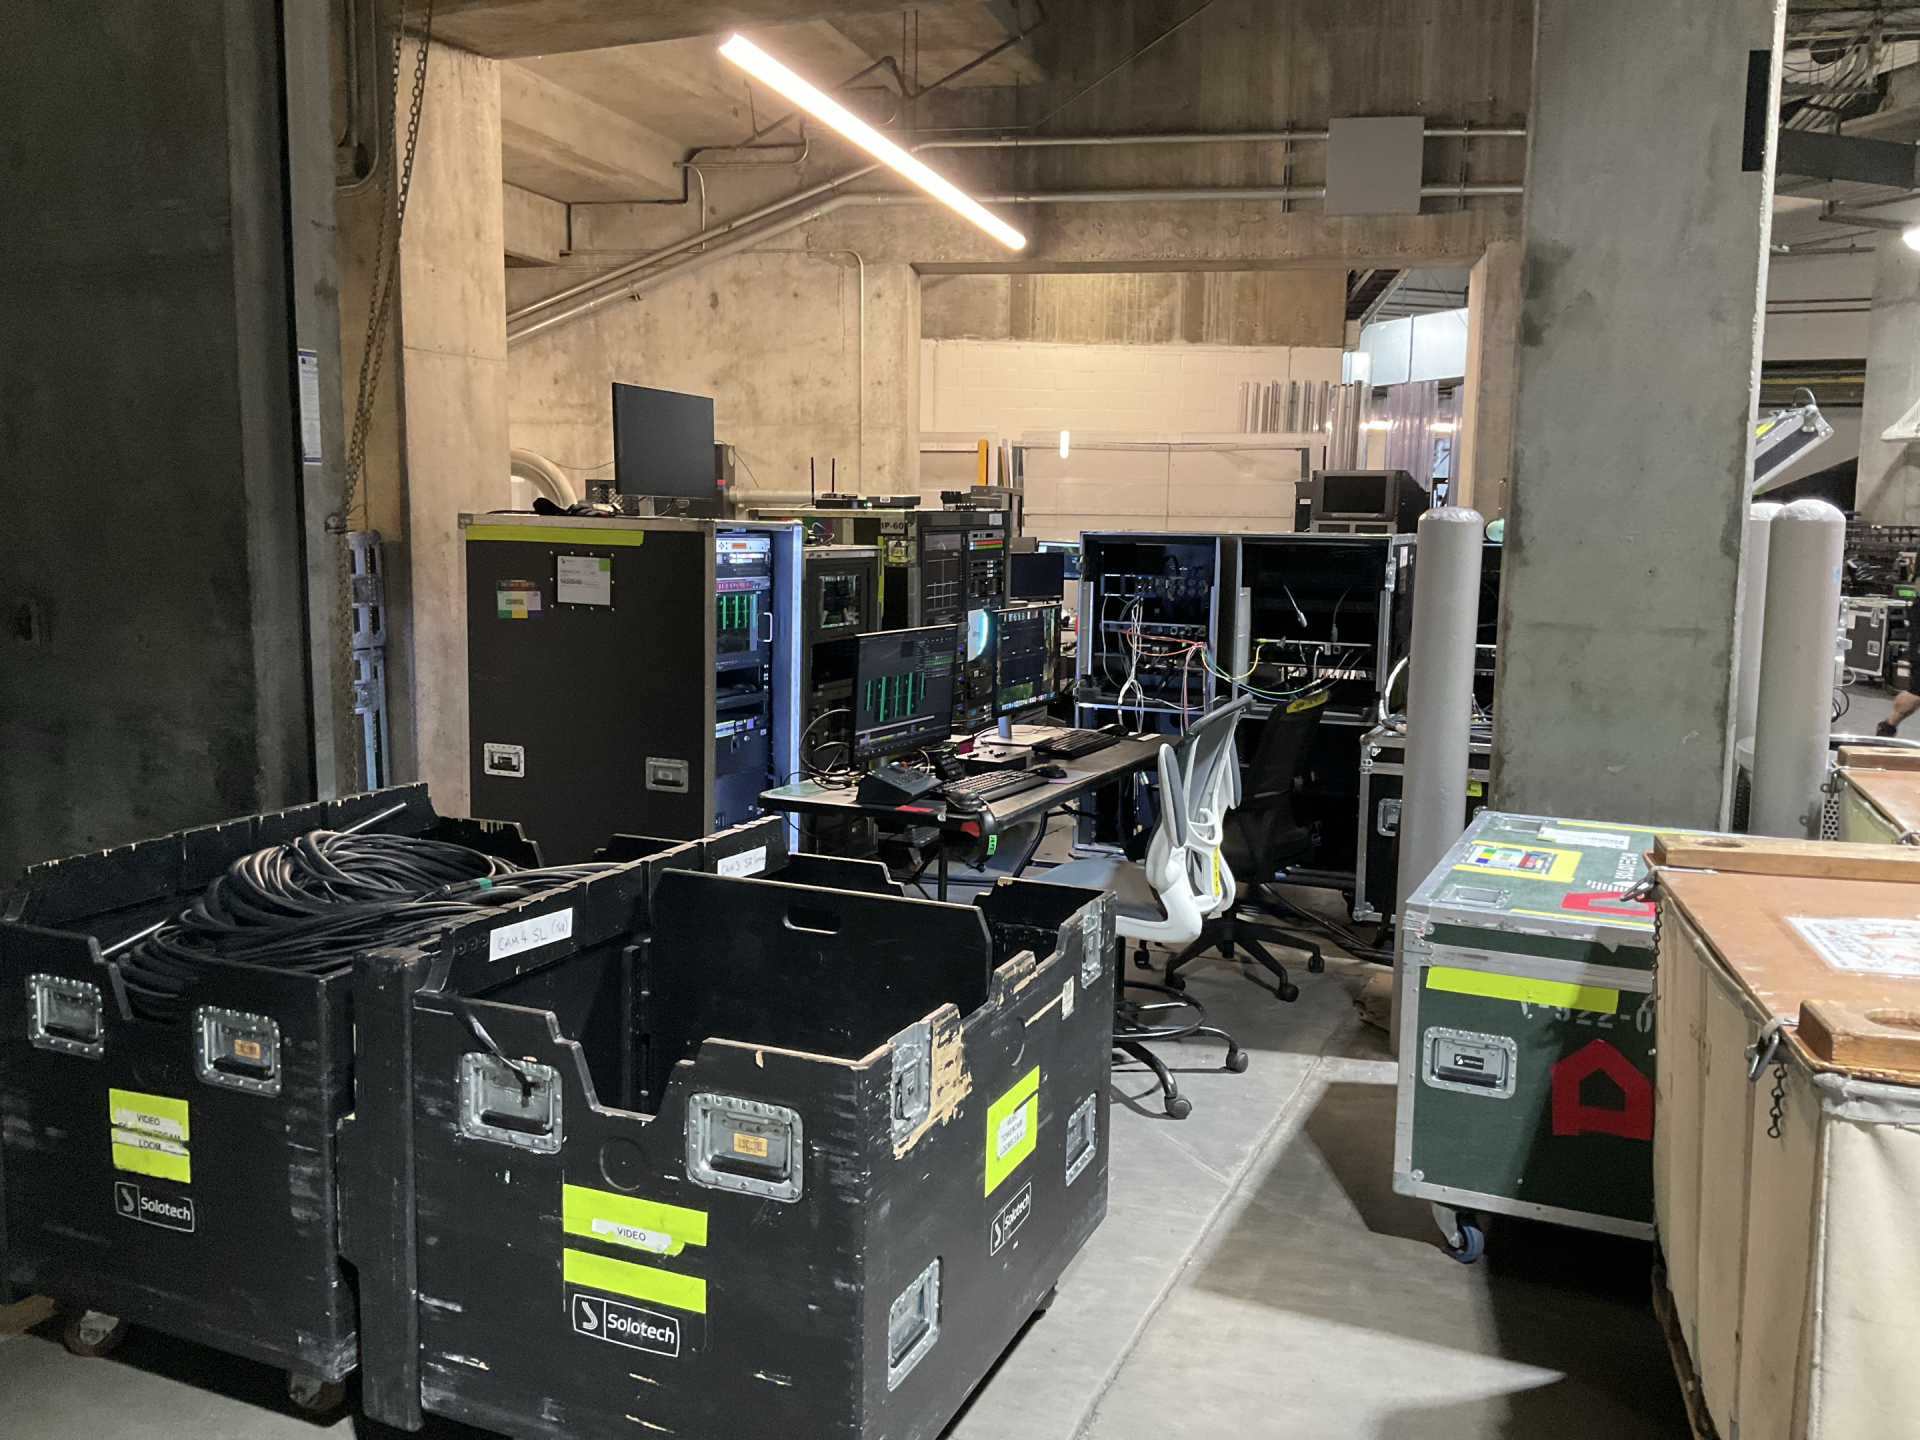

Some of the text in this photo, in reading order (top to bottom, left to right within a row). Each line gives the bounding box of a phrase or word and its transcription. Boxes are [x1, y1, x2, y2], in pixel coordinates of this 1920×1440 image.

[881, 521, 904, 530] IP-60
[498, 936, 520, 950] CAM
[521, 930, 528, 943] 4
[532, 928, 548, 943] SL
[137, 1114, 160, 1126] VIDEO
[139, 1139, 161, 1151] LOOM
[141, 1197, 190, 1220] Solotech
[1004, 1193, 1030, 1230] Solotech
[617, 1226, 647, 1242] VIDEO
[607, 1313, 675, 1344] Solotech
